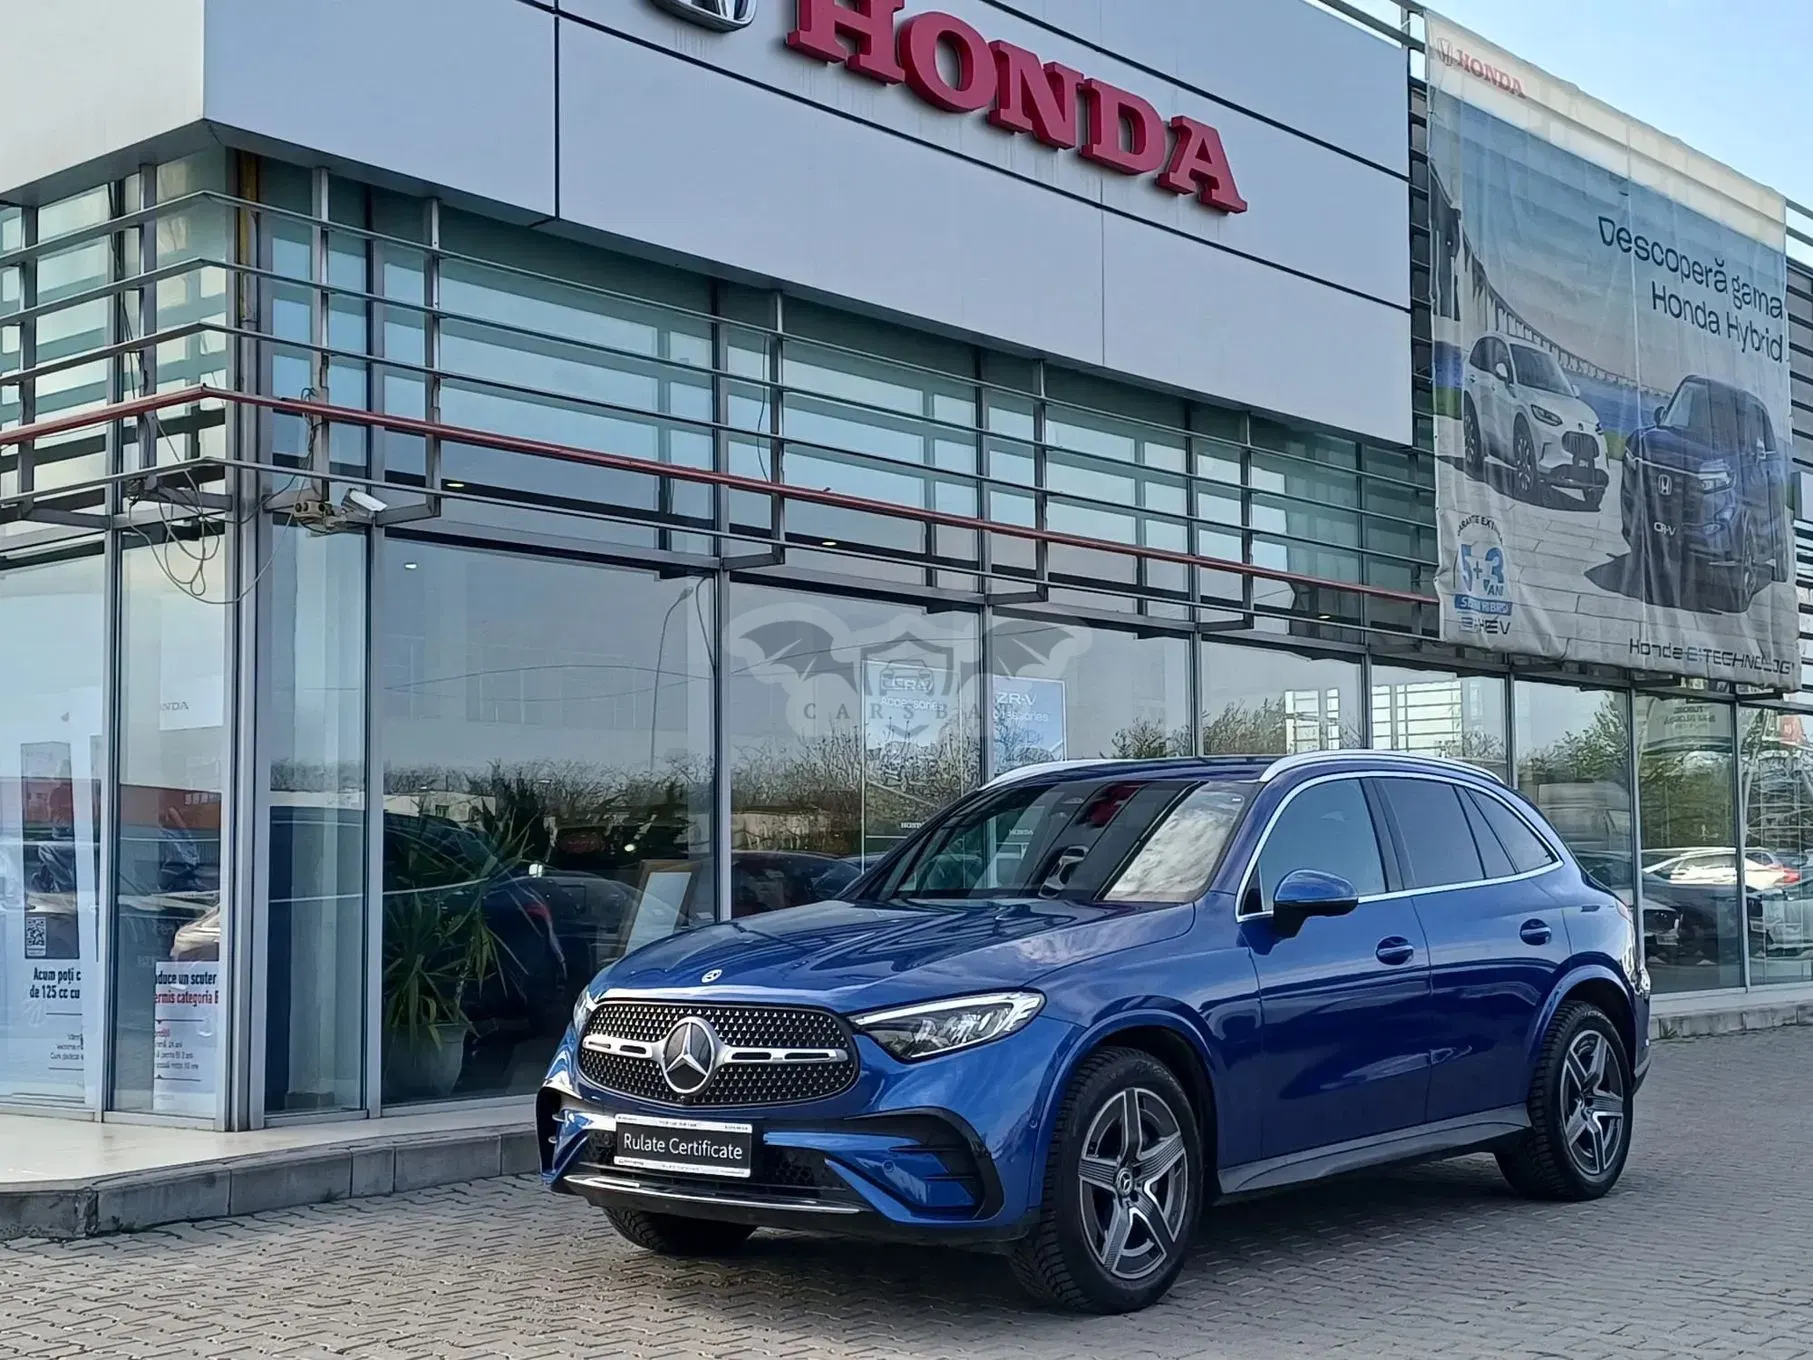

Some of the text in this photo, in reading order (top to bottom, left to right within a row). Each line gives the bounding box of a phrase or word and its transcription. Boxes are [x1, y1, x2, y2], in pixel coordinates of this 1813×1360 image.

[1456, 48, 1526, 99] HONDA
[786, 0, 1247, 214] HONDA
[1598, 216, 1783, 319] Descoperă gama
[1652, 281, 1783, 363] Honda Hybrid
[997, 692, 1037, 706] ZR-V
[33, 967, 56, 981] Acum
[178, 974, 189, 985] un
[191, 971, 217, 985] scuter
[30, 985, 80, 999] de 125 cc cu
[177, 991, 212, 1007] categoria
[623, 1132, 743, 1160] Rulate Certificate
